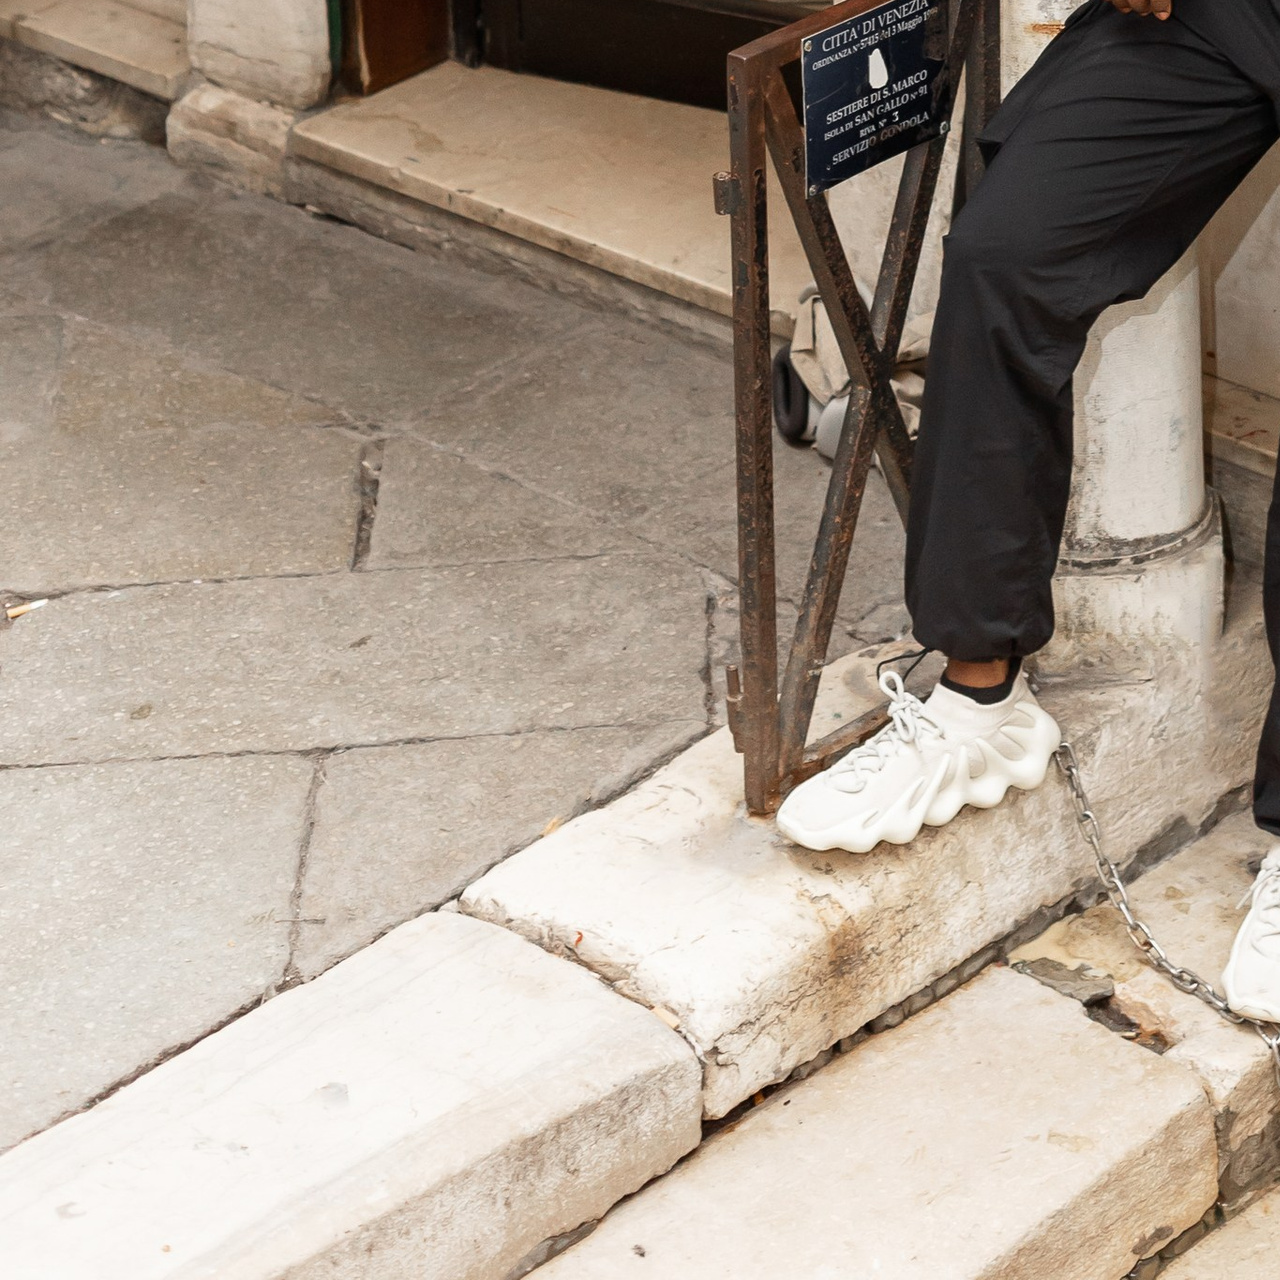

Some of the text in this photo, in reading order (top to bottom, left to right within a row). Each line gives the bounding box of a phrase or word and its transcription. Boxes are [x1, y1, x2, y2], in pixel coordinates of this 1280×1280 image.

[812, 48, 852, 71] ORDINANZA
[897, 15, 923, 34] Maggio
[862, 19, 876, 35] DI
[823, 126, 845, 141] ISOLA
[845, 120, 854, 132] DI
[854, 107, 876, 127] SAN
[876, 92, 910, 116] GALLO
[826, 96, 869, 125] SESTIERE
[870, 90, 882, 105] DI
[882, 87, 892, 100] S.
[892, 69, 928, 95] MARCO
[832, 111, 930, 166] SERVIZIO GONDOLA
[859, 125, 876, 138] RIVA
[892, 109, 900, 123] 3
